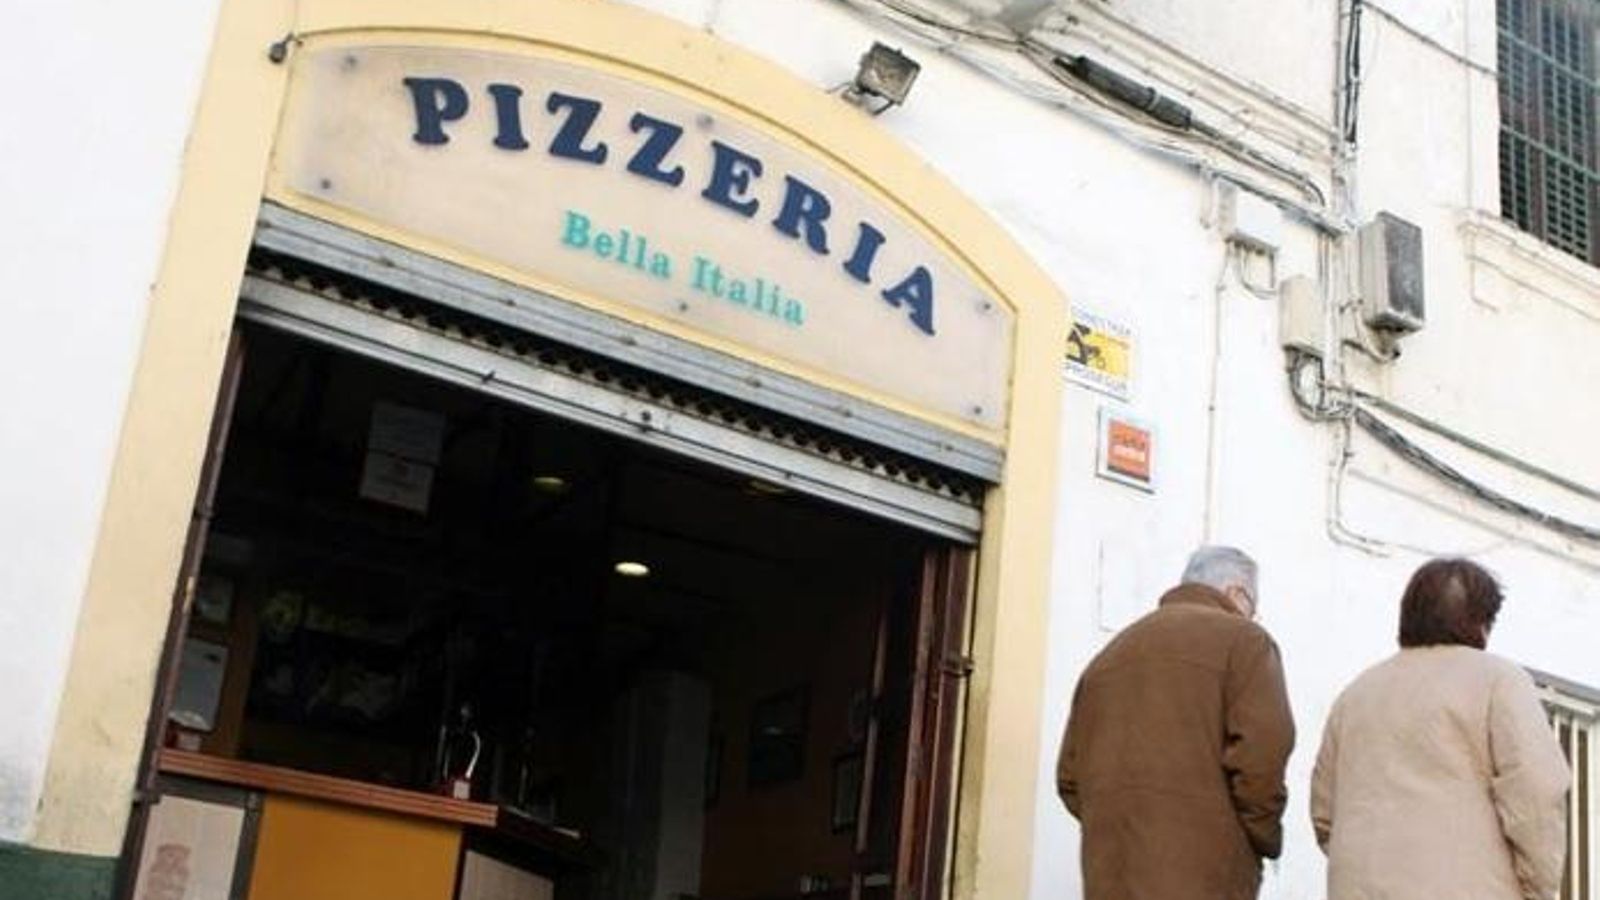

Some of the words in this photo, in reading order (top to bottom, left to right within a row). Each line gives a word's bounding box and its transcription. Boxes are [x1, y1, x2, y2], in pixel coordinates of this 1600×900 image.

[404, 76, 936, 336] PIZZERIA
[562, 210, 672, 279] Bella
[692, 256, 805, 327] Italia
